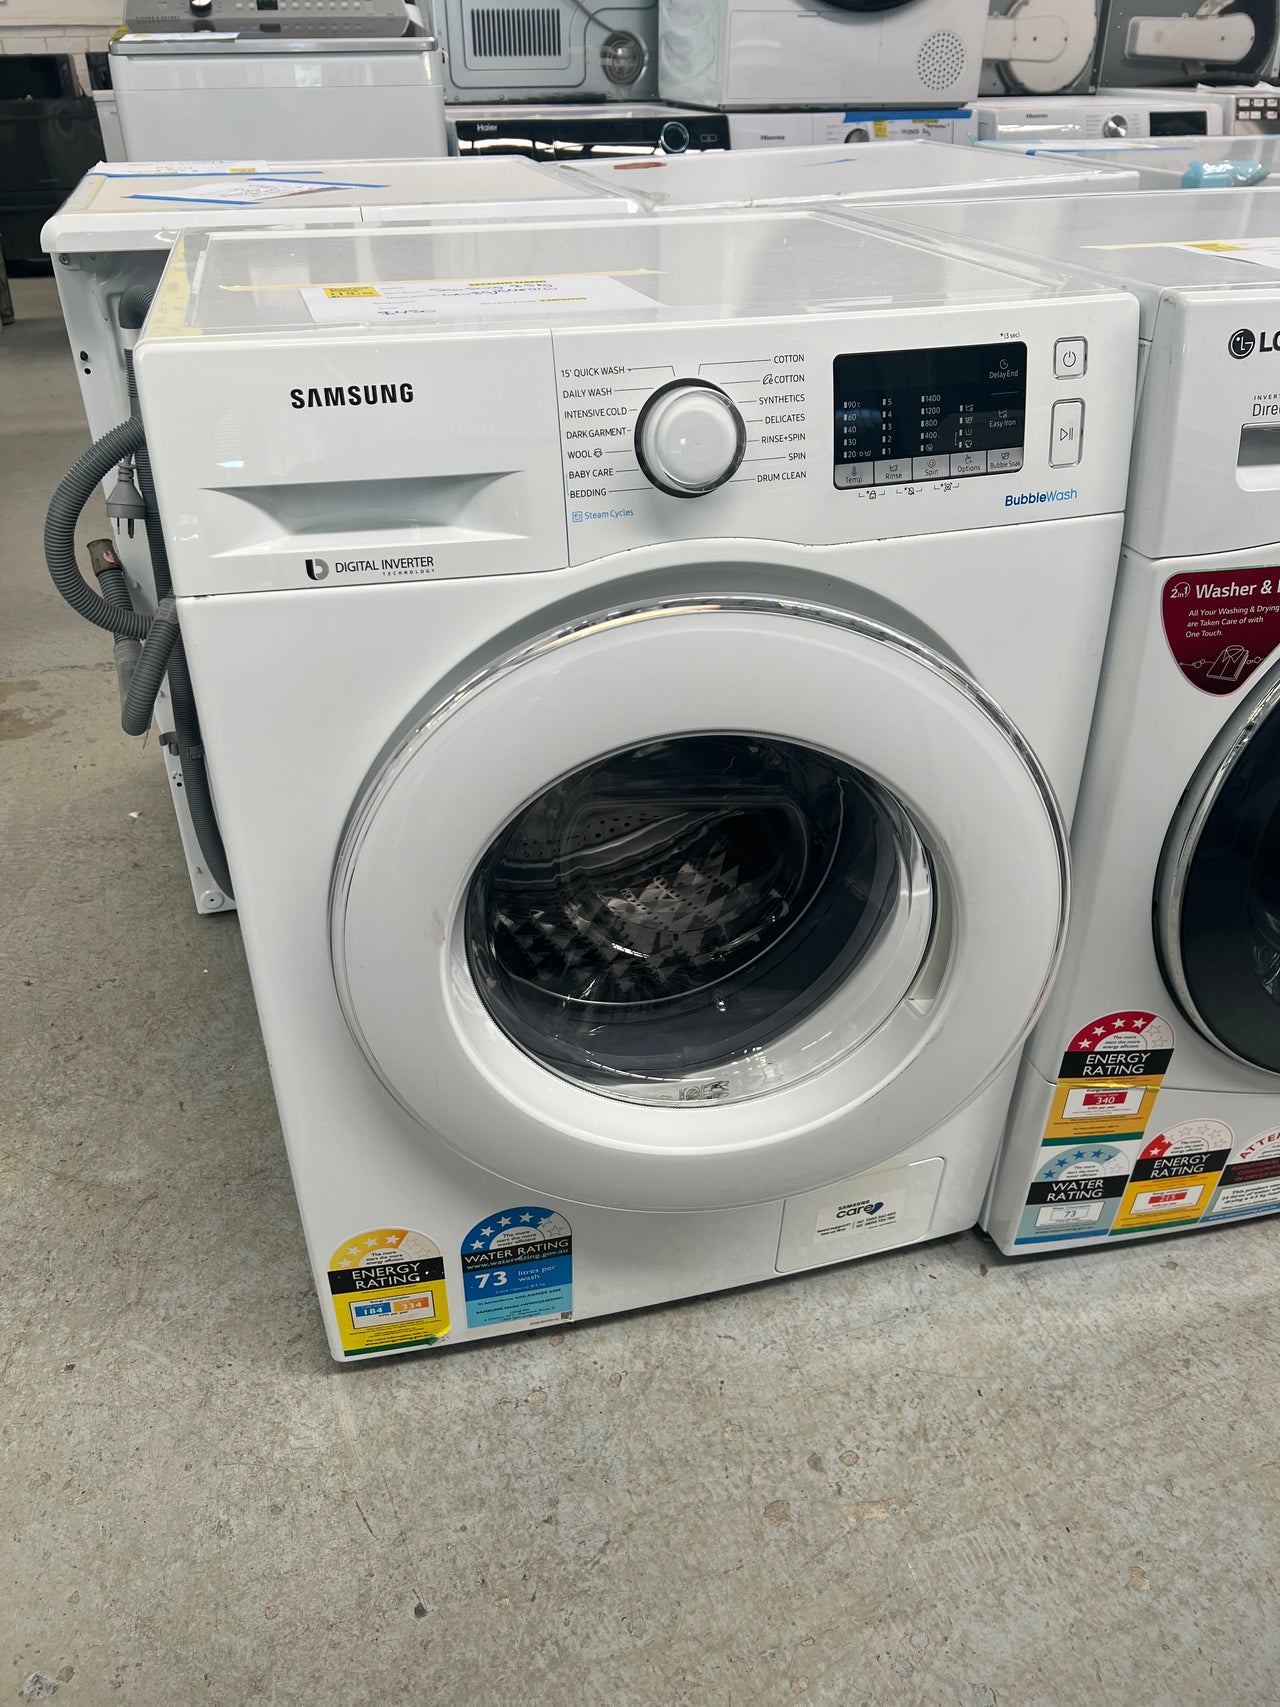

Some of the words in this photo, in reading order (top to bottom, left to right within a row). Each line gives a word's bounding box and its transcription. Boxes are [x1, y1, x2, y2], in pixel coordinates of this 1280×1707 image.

[477, 124, 497, 132] Haier
[774, 354, 804, 364] COTTON
[573, 367, 599, 377] QUICK
[600, 366, 625, 375] WASH
[989, 370, 1006, 379] Delay
[1007, 370, 1018, 378] End
[290, 382, 414, 409] SAMSUNG
[563, 390, 586, 399] DAILY
[587, 387, 612, 397] WASH
[925, 394, 941, 403] 1400
[759, 394, 805, 405] SYNTHETICS
[564, 408, 605, 419] INTENSIVE
[605, 407, 627, 417] COLD
[924, 407, 940, 415] 1200
[1253, 403, 1280, 417] Dire
[765, 414, 805, 424] DELICATES
[848, 413, 856, 421] 60
[924, 419, 938, 427] 800
[990, 419, 1003, 428] Easy
[1004, 418, 1016, 427] Iron
[566, 429, 589, 440] DARK
[589, 427, 626, 438] GARMENT
[848, 426, 856, 434] 40
[924, 431, 938, 439] 400
[761, 433, 806, 444] RINSE+SPIN
[567, 450, 592, 459] WOOL
[788, 452, 806, 461] SPIN
[848, 450, 856, 458] 20
[957, 463, 981, 473] Options
[990, 461, 1007, 469] Bubble
[1008, 459, 1021, 468] Soak
[569, 470, 591, 479] BABY
[592, 468, 614, 477] CARE
[757, 472, 780, 482] DRUM
[781, 471, 806, 481] CLEAN
[885, 471, 902, 480] Rinse
[924, 467, 939, 476] Spin
[845, 475, 863, 484] Temp
[570, 488, 606, 498] BEDDING
[1005, 488, 1078, 507] BubbleWash
[584, 510, 609, 520] Steam
[610, 508, 634, 518] Cycles
[335, 560, 379, 574] DIGITAL
[381, 556, 434, 571] INVERTER
[1196, 582, 1257, 599] Washer
[1260, 580, 1272, 595] &
[1256, 605, 1280, 613] Drying
[1086, 1052, 1151, 1064] ENERGY
[1082, 1064, 1144, 1076] RATING
[1096, 1096, 1115, 1105] 340
[1154, 1153, 1210, 1169] ENERGY
[1150, 1164, 1204, 1179] RATING
[1052, 1179, 1104, 1191] WATER
[1047, 1189, 1103, 1202] RATING
[836, 1204, 874, 1218] care
[465, 1250, 512, 1263] WATER
[517, 1239, 569, 1255] RATING
[352, 1262, 420, 1280] ENERGY
[542, 1265, 556, 1273] per
[356, 1272, 420, 1290] RATING
[475, 1271, 507, 1289] 73
[364, 1307, 383, 1315] 184
